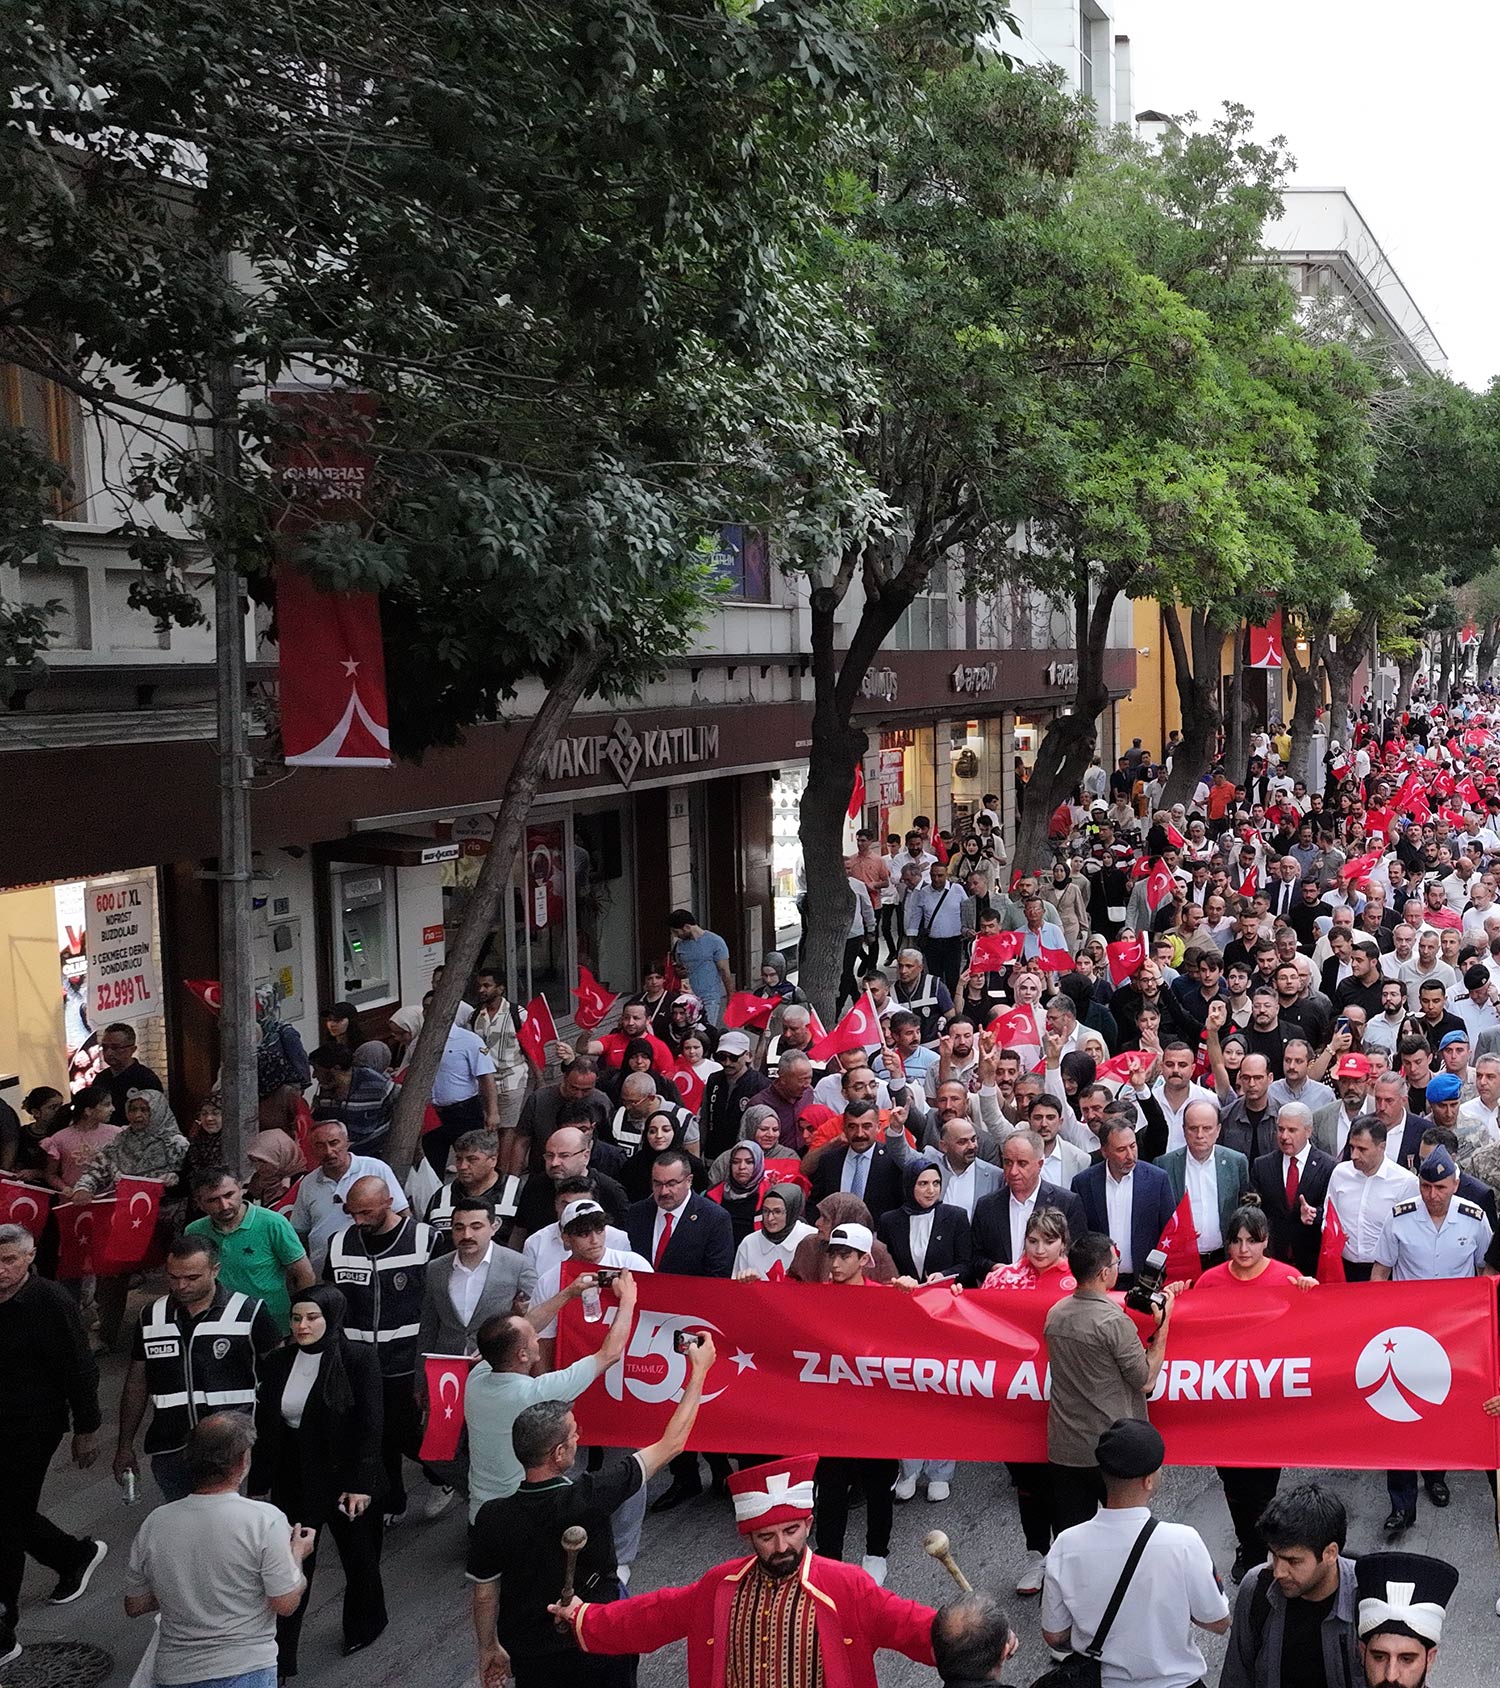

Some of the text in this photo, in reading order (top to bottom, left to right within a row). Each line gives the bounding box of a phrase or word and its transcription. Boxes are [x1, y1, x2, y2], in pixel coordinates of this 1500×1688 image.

[641, 724, 719, 767] KATILIM
[96, 892, 115, 913] 600
[117, 891, 128, 909] LT
[129, 889, 142, 907] XL
[105, 911, 132, 926] NOFROST
[101, 924, 139, 942] BUZDOLABI
[92, 955, 97, 965] 3
[101, 957, 143, 976] DONDURUCU
[97, 974, 150, 1011] 32.999 TL
[626, 1364, 665, 1374] TEMMUZ
[793, 1350, 998, 1399] ZAFERİN
[1006, 1360, 1053, 1401] A
